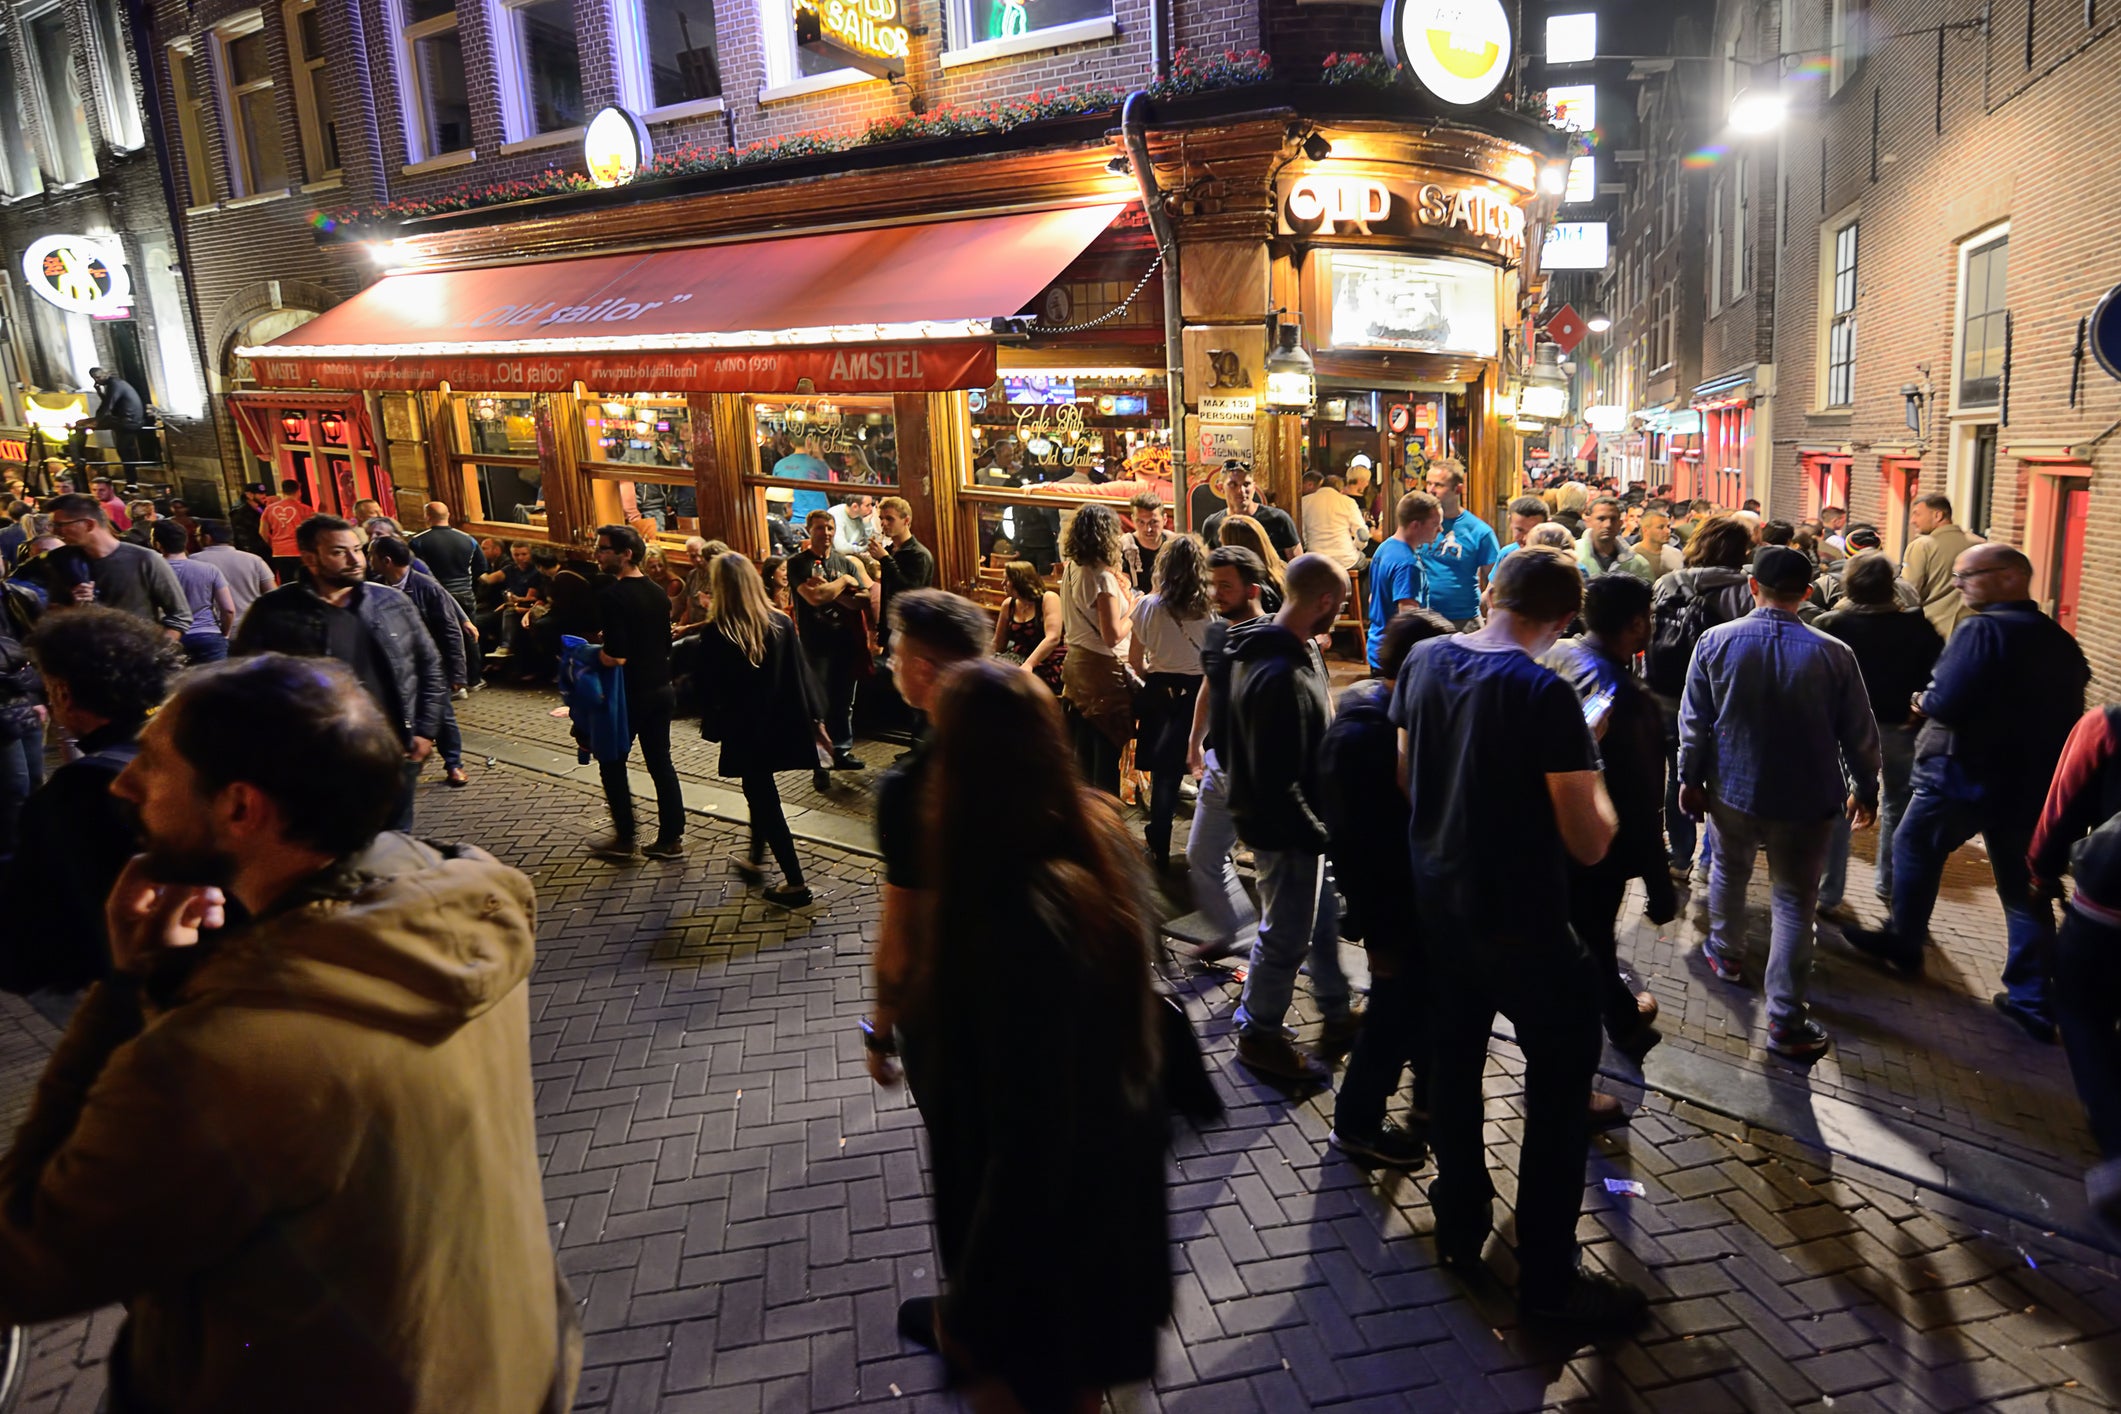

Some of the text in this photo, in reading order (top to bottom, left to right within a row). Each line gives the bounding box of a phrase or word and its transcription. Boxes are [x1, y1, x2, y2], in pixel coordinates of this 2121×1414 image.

[842, 0, 897, 20] LD
[828, 0, 910, 57] SAILOR
[1289, 175, 1526, 247] OLD SAILOR
[749, 357, 777, 372] 1930
[829, 350, 924, 381] AMSTEL
[1203, 399, 1250, 408] MAX. 130
[1011, 404, 1050, 443] Café
[1056, 403, 1085, 434] Pub
[1200, 411, 1254, 421] PERSONEN
[1038, 444, 1059, 467] Old
